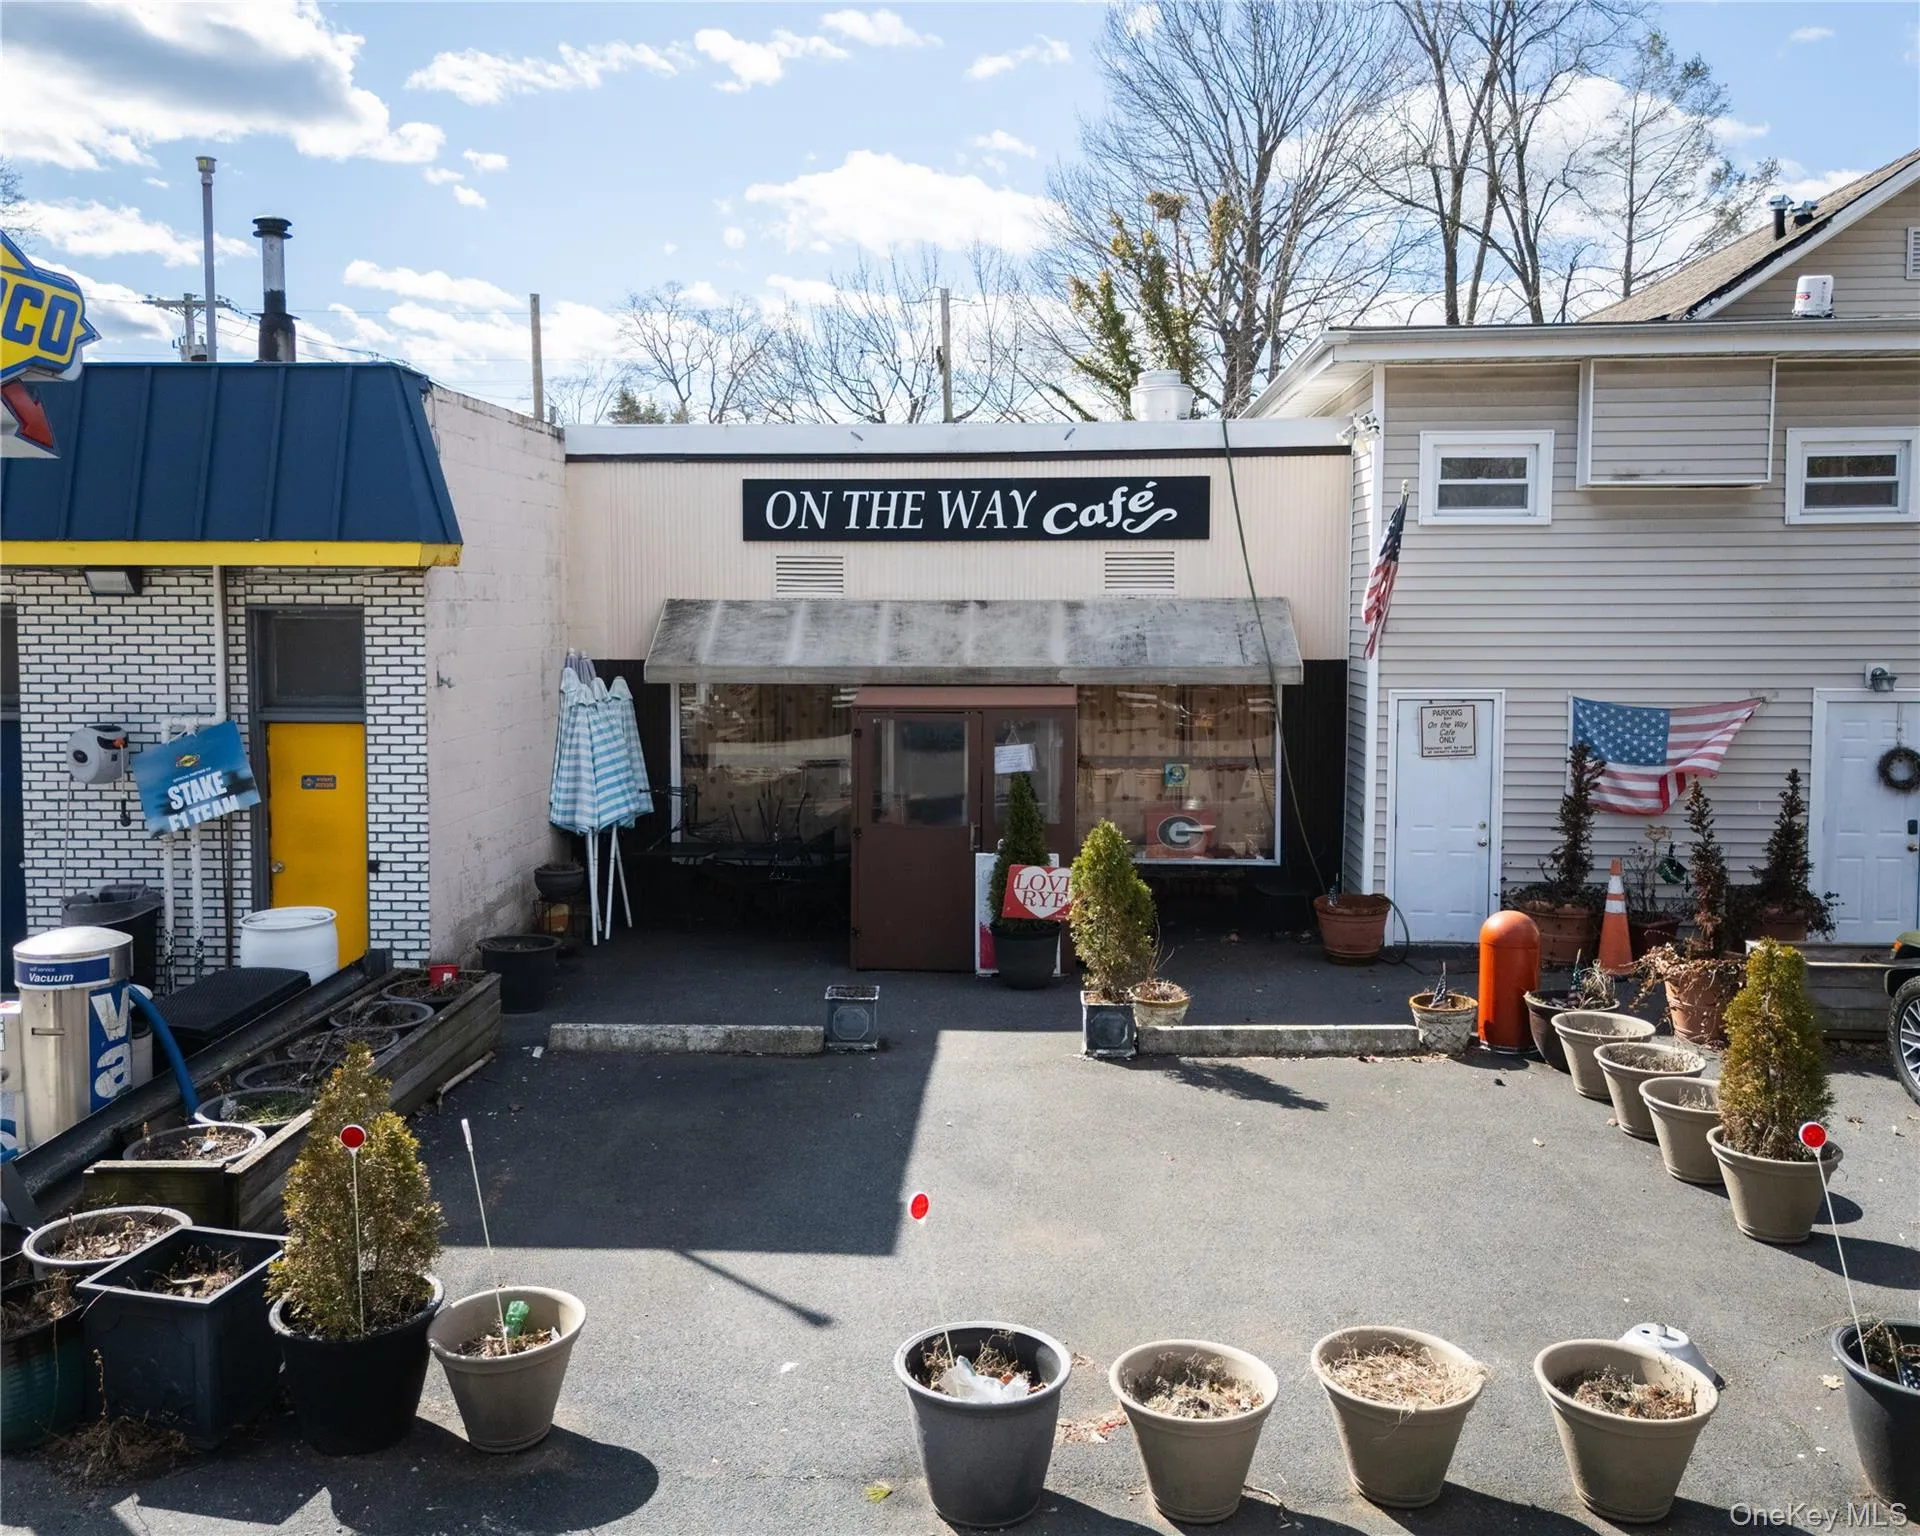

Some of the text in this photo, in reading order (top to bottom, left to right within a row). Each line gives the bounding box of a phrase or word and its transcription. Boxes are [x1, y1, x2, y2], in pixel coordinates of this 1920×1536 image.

[0, 277, 78, 357] CO
[765, 481, 1178, 535] ON THE WAY Café
[1432, 708, 1463, 717] PARKING
[1427, 720, 1469, 730] On the Way
[1439, 736, 1456, 744] ONLY
[167, 770, 228, 811] STAKE
[168, 794, 240, 833] F1 TEAM
[1022, 890, 1068, 908] RYE
[29, 972, 75, 983] Vacuum
